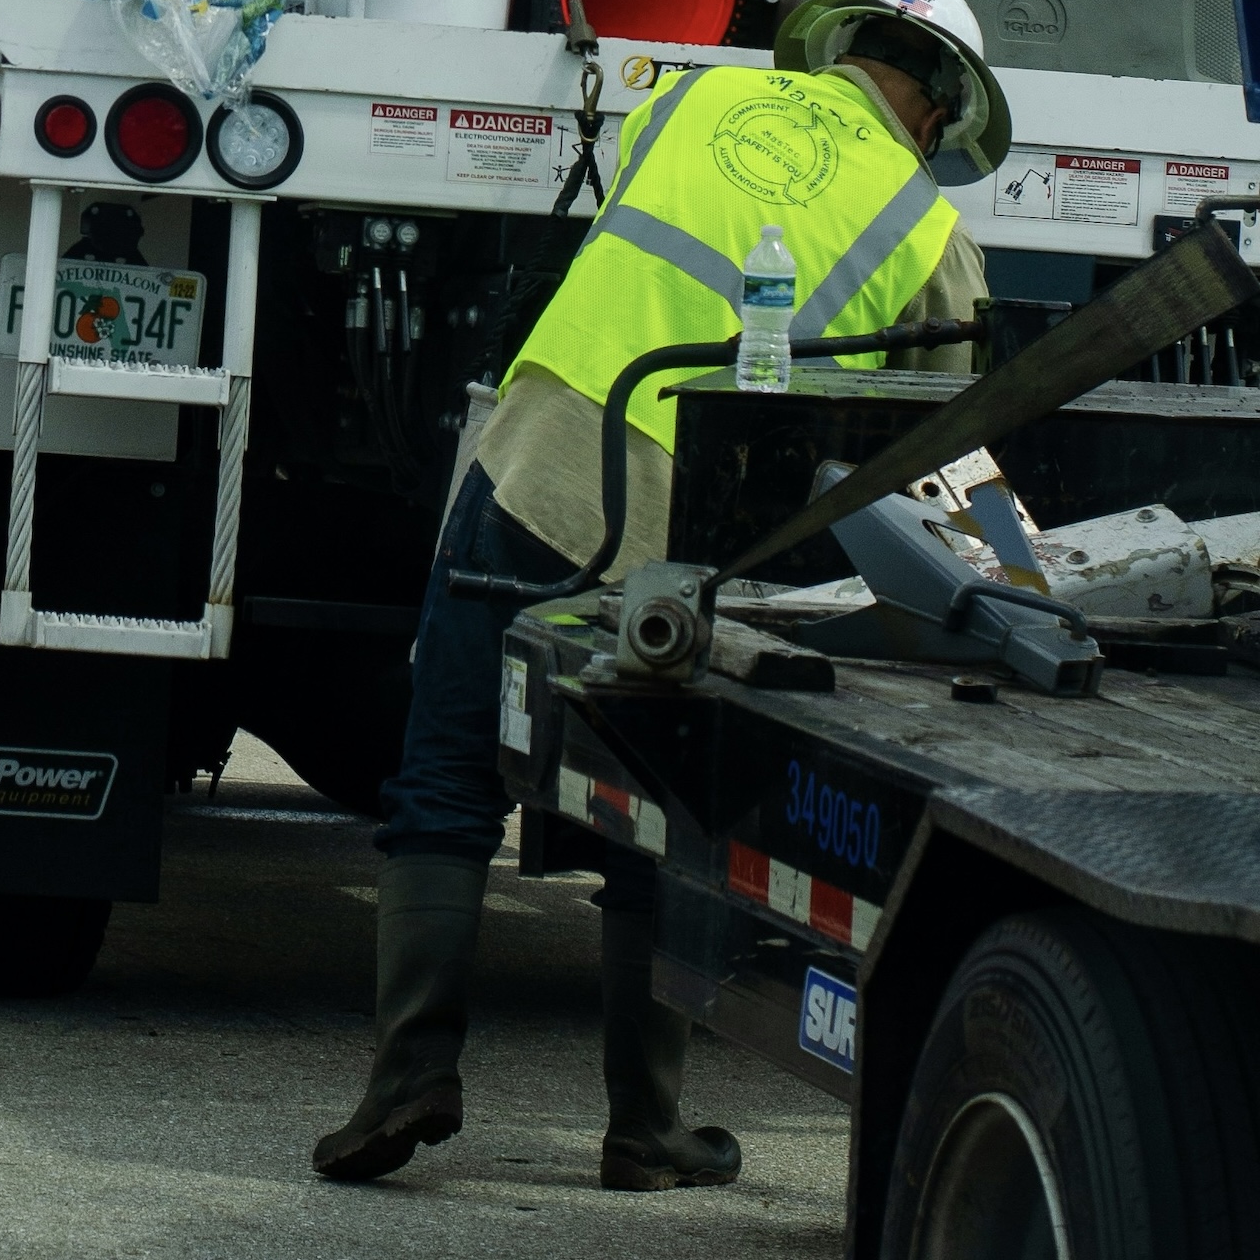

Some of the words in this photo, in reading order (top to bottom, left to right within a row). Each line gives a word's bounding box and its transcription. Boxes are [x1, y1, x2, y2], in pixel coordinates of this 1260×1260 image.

[1003, 21, 1059, 36] IGLOO
[386, 107, 434, 120] DANGER
[728, 103, 790, 125] COMMITMENT
[472, 114, 547, 134] DANGER
[455, 133, 514, 142] ELECTROCUTION
[516, 136, 546, 145] HAZARD
[740, 135, 773, 156] SAFETY
[772, 155, 782, 163] IS
[783, 161, 802, 178] YOU
[806, 137, 832, 192] INVOLVEMENT
[1082, 161, 1125, 171] DANGER
[719, 146, 776, 197] ACCOUNTABILITY
[1180, 166, 1226, 178] DANGER
[55, 267, 161, 295] YFLORIDA.COM
[48, 342, 105, 360] UNSHINE
[786, 758, 880, 870] 349050
